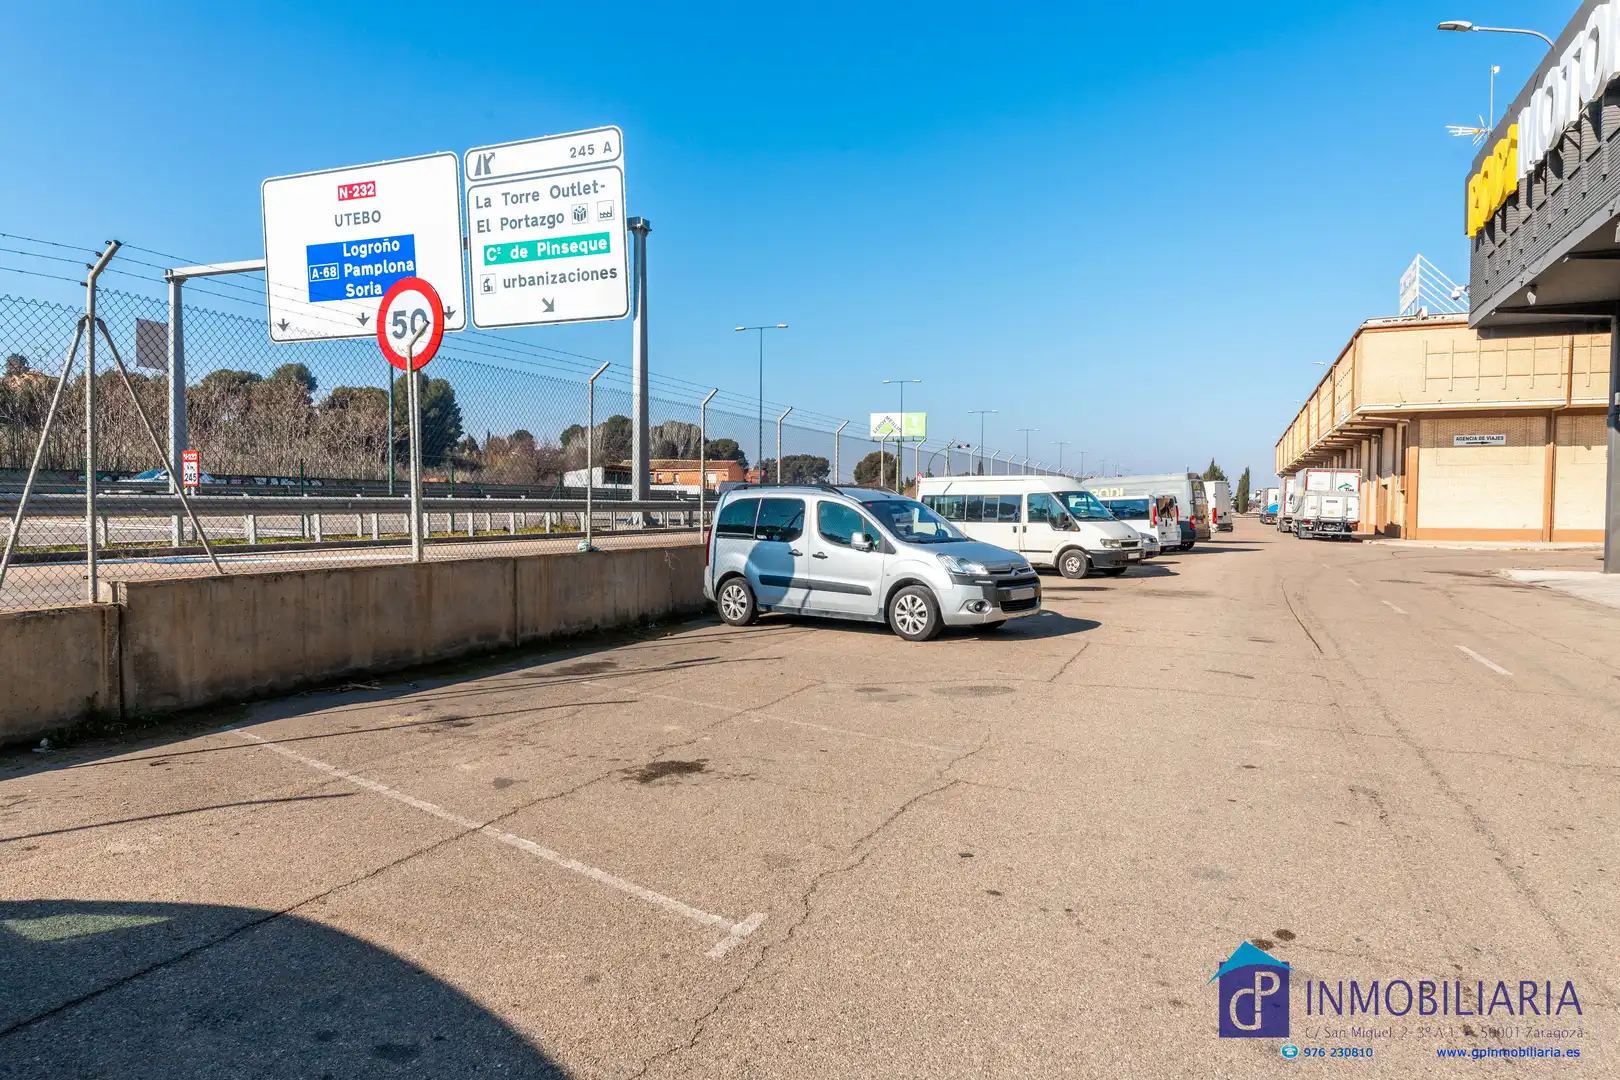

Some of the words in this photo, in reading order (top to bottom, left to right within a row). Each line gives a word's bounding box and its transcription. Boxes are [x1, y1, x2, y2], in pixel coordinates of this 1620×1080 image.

[569, 144, 595, 159] 245
[603, 141, 612, 154] A
[338, 183, 376, 200] N-232
[475, 195, 492, 209] La
[502, 190, 540, 206] Torre
[549, 180, 606, 199] Outlet-
[334, 210, 381, 227] UTEBO
[477, 218, 491, 234] El
[500, 212, 565, 231] Portazgo
[342, 238, 400, 259] Logroño
[510, 245, 528, 259] de
[537, 238, 608, 257] Pinseque
[311, 266, 337, 280] A-68
[344, 260, 415, 278] Pamplona
[503, 267, 617, 289] urbanizaciones
[345, 281, 383, 298] Soria
[392, 308, 428, 340] 50
[872, 419, 887, 433] LEROY
[184, 473, 197, 482] 245
